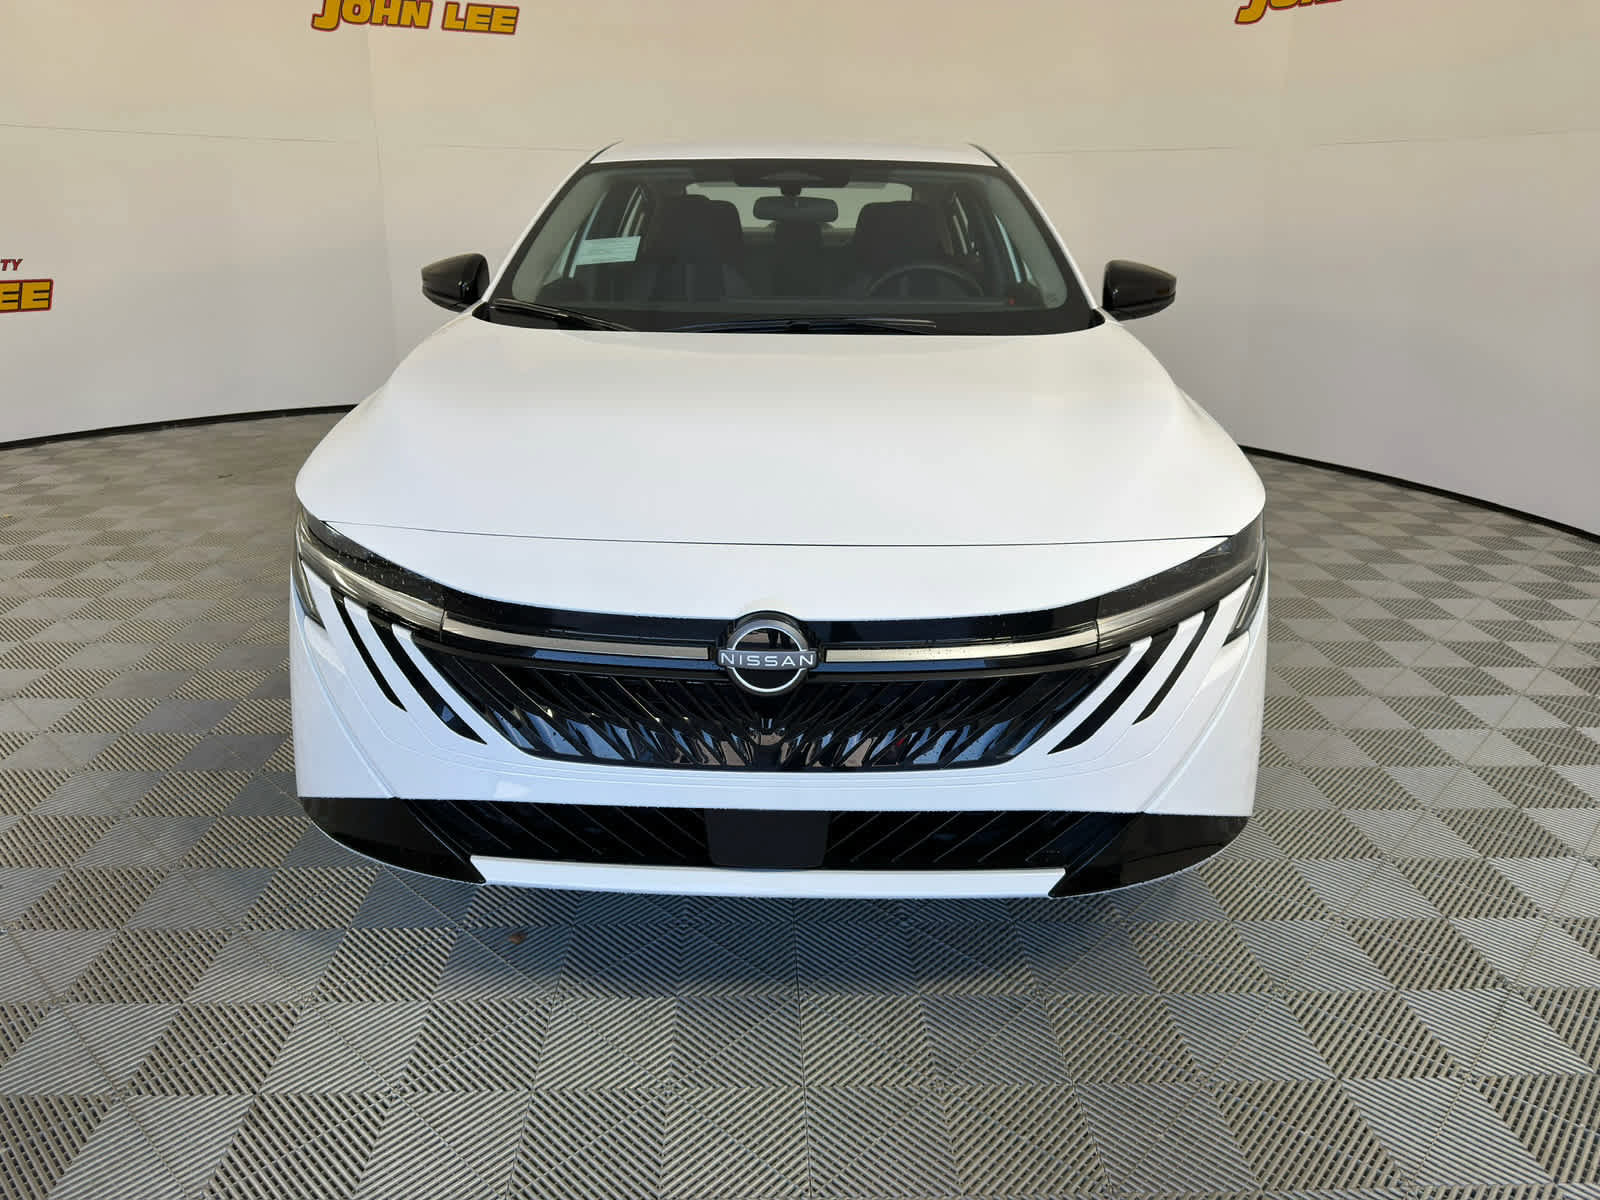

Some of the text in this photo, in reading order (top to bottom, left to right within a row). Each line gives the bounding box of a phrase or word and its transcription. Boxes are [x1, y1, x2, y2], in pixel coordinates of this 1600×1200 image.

[311, 0, 520, 35] JOHN LEE
[720, 652, 814, 667] NISSAN
